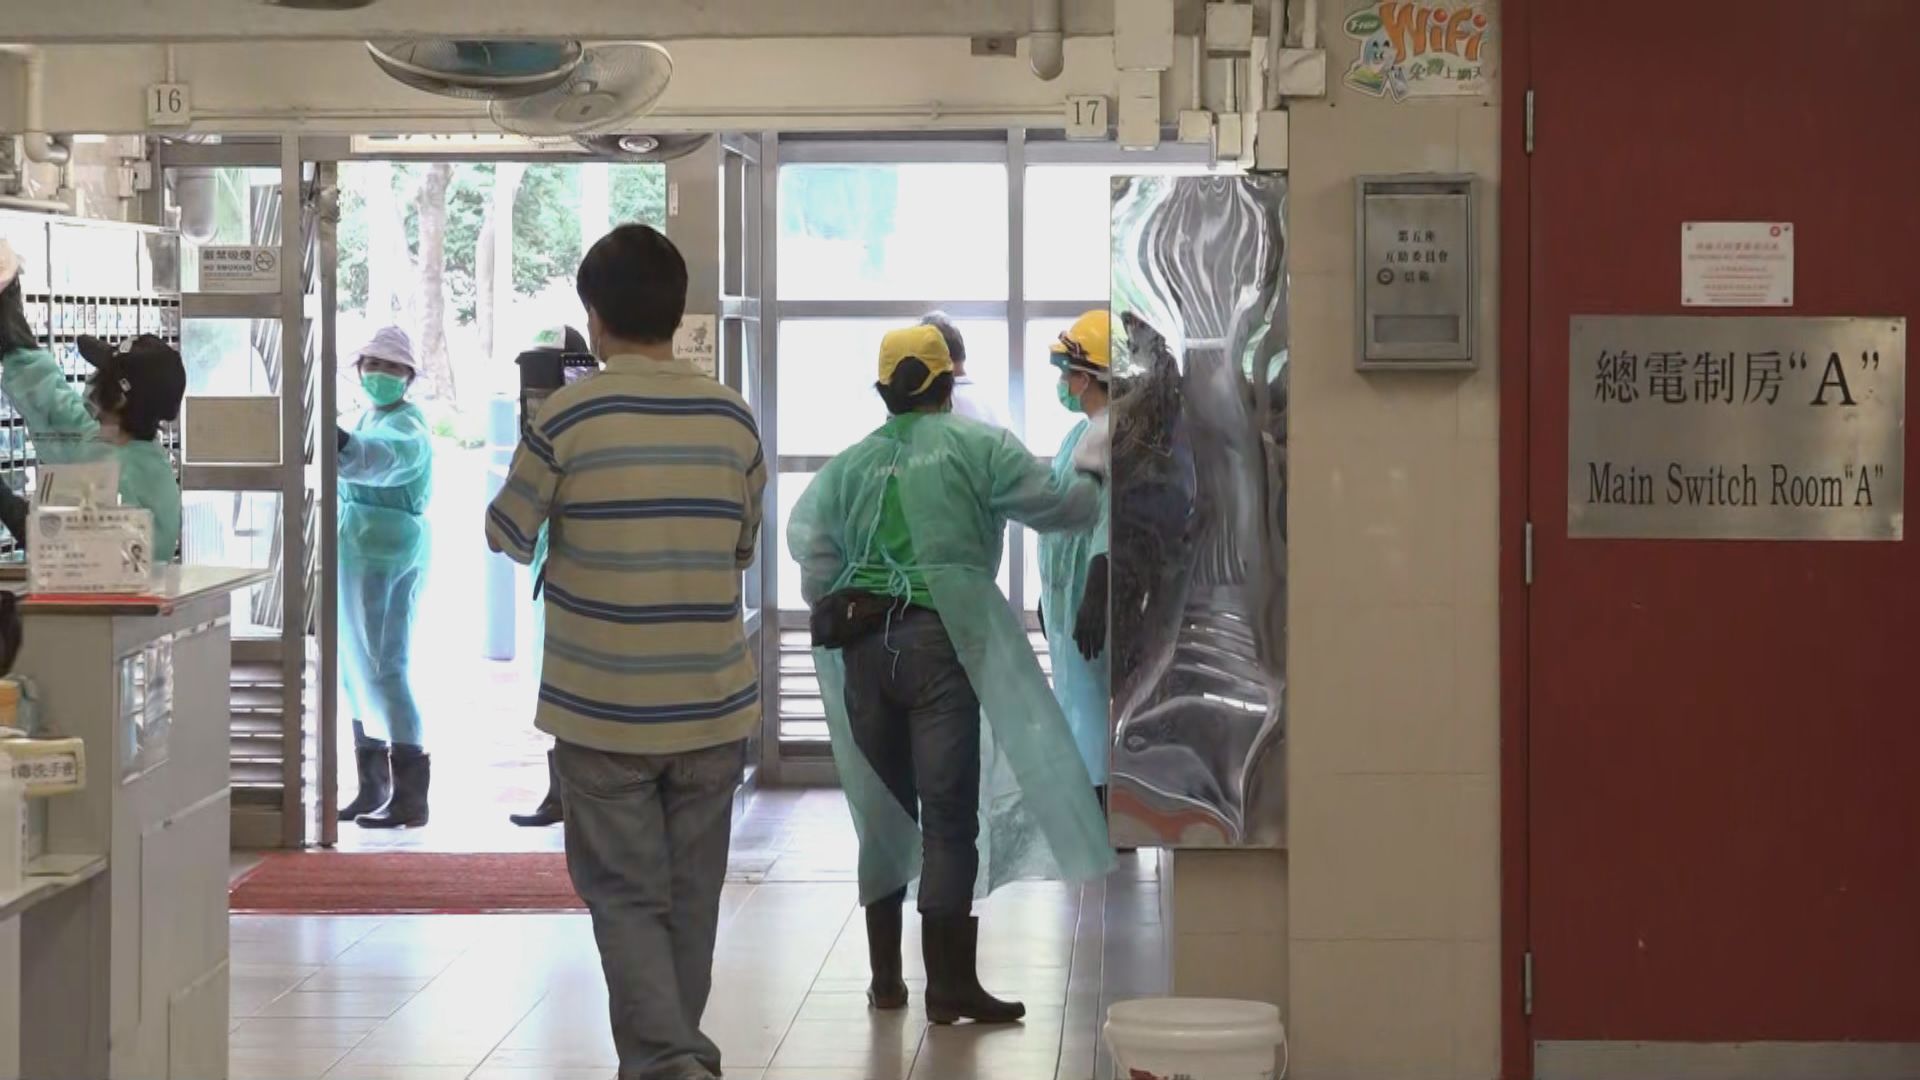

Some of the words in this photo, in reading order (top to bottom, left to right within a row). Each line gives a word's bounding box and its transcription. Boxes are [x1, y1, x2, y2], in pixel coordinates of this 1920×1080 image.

[1379, 1, 1487, 63] WiFi
[155, 88, 182, 113] 16
[1074, 100, 1099, 126] 17
[216, 263, 253, 272] SMOKING
[1587, 461, 1655, 506] Main
[1665, 461, 1758, 507] Switch
